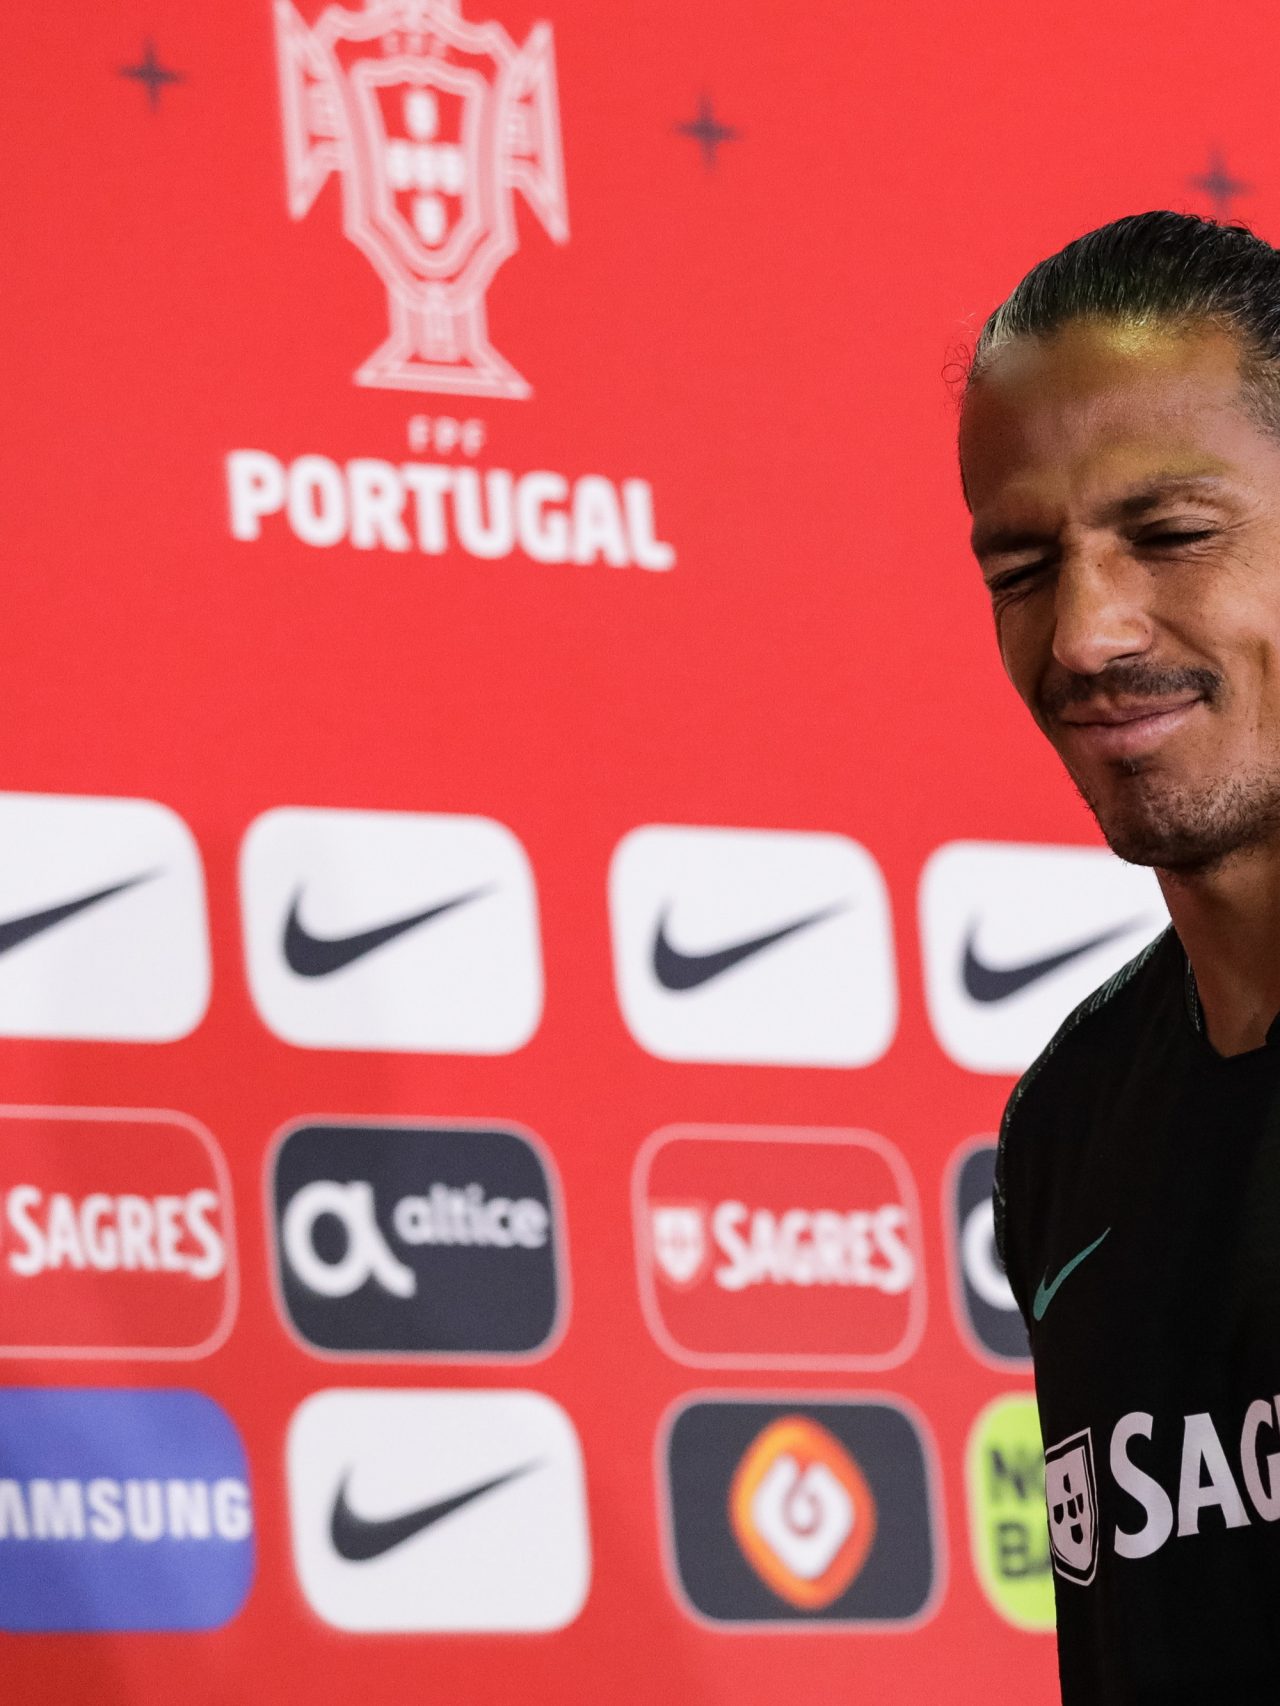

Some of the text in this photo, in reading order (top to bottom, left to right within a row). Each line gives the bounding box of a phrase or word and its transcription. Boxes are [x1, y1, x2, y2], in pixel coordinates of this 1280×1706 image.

[226, 448, 676, 572] PORTUGAL
[6, 1185, 224, 1280] SAGRES
[393, 1183, 549, 1249] altice
[712, 1199, 914, 1294] SAGRES
